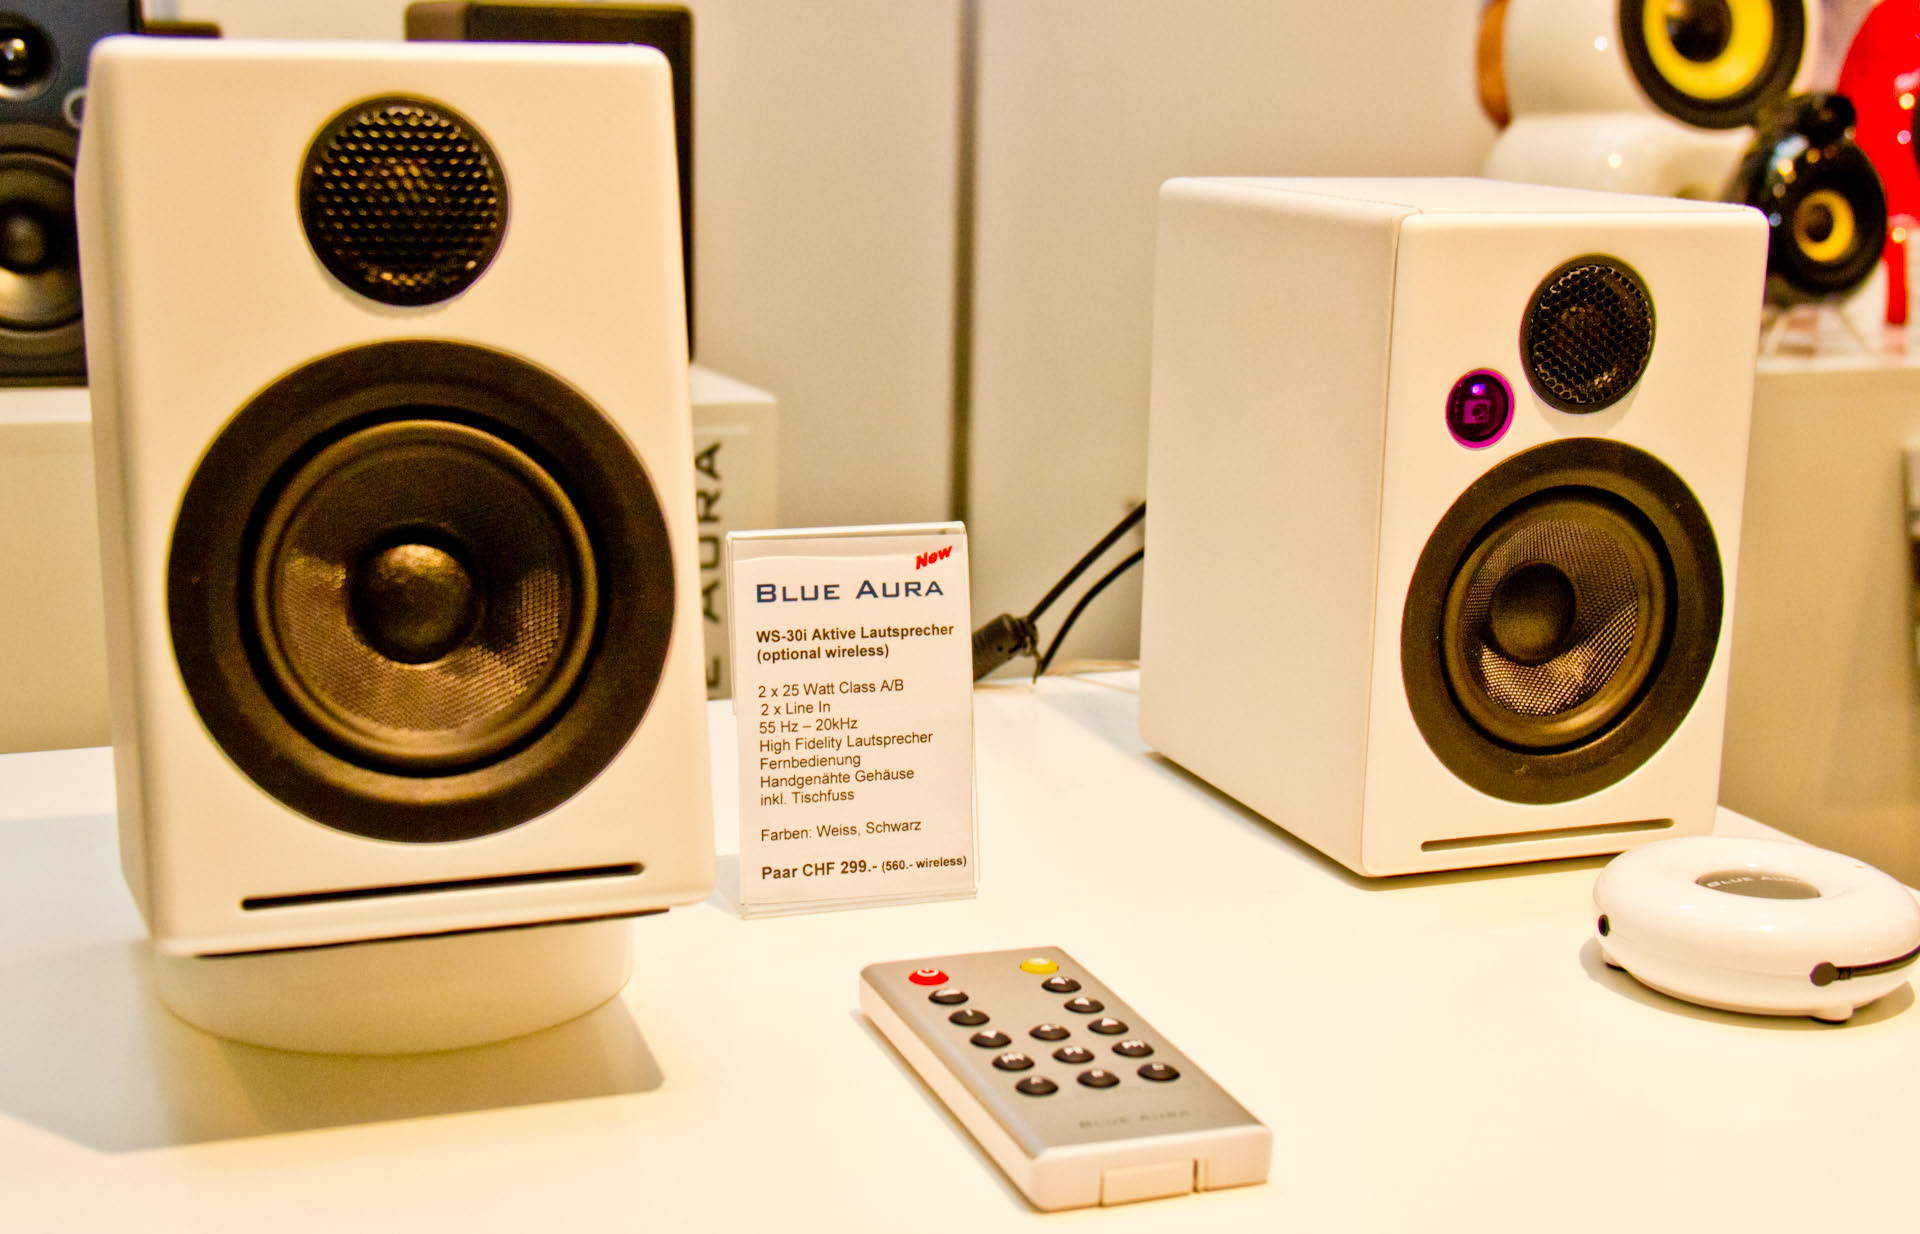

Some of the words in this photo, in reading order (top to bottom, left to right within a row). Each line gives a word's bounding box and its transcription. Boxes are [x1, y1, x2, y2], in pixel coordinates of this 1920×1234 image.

[695, 441, 722, 624] AURA
[915, 546, 953, 570] New
[756, 583, 841, 603] BLUE
[855, 580, 944, 600] AURA
[756, 629, 807, 643] WS-30i
[811, 627, 856, 642] Aktive
[860, 624, 954, 641] Lautsprecher
[756, 646, 821, 665] (optional
[825, 644, 890, 659] wireless)
[758, 686, 767, 698] 2
[771, 687, 779, 697] x
[783, 684, 800, 697] 25
[803, 682, 835, 696] Watt
[839, 680, 876, 694] Class
[880, 678, 905, 692] A/B
[760, 703, 770, 716] 2
[774, 705, 782, 715] x
[786, 701, 814, 715] Line
[818, 701, 831, 713] In
[759, 721, 776, 734] 55
[780, 720, 799, 733] Hz
[815, 717, 858, 731] 20kHz
[759, 739, 791, 754] High
[795, 736, 842, 751] Fidelity
[846, 732, 934, 748] Lautsprecher
[759, 754, 861, 770] Fernbedienung
[759, 772, 851, 789] Handgenähte
[854, 768, 915, 783] Gehäuse
[760, 793, 787, 806] inkl.
[791, 789, 855, 804] Tischfuss
[760, 827, 812, 842] Farben:
[816, 823, 861, 838] Weiss,
[865, 820, 922, 834] Schwarz
[761, 865, 798, 880] Paar
[802, 862, 835, 877] CHF
[840, 859, 877, 874] 299.-
[881, 859, 913, 873] (560.-
[915, 855, 967, 870] wireless)
